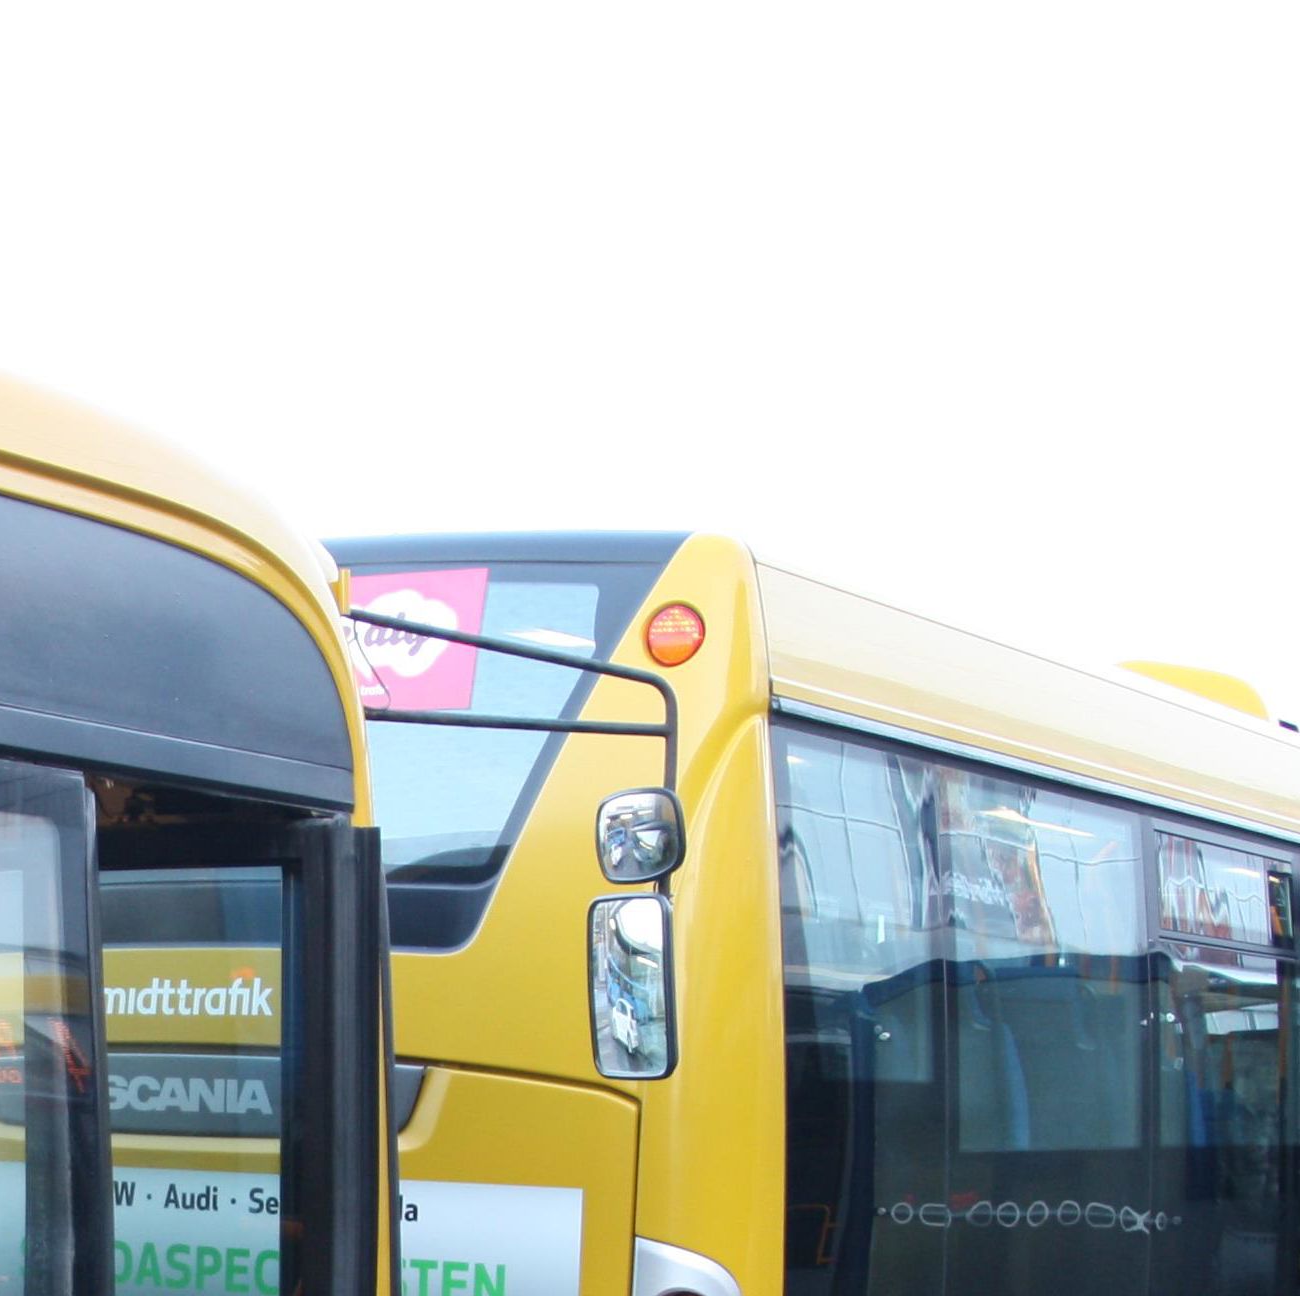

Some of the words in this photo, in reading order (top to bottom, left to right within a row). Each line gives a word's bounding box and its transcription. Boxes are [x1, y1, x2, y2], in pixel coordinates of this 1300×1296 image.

[107, 1074, 273, 1116] SCANIA
[113, 1180, 136, 1207] W
[163, 1183, 219, 1212] Audi
[248, 1187, 279, 1215] Se
